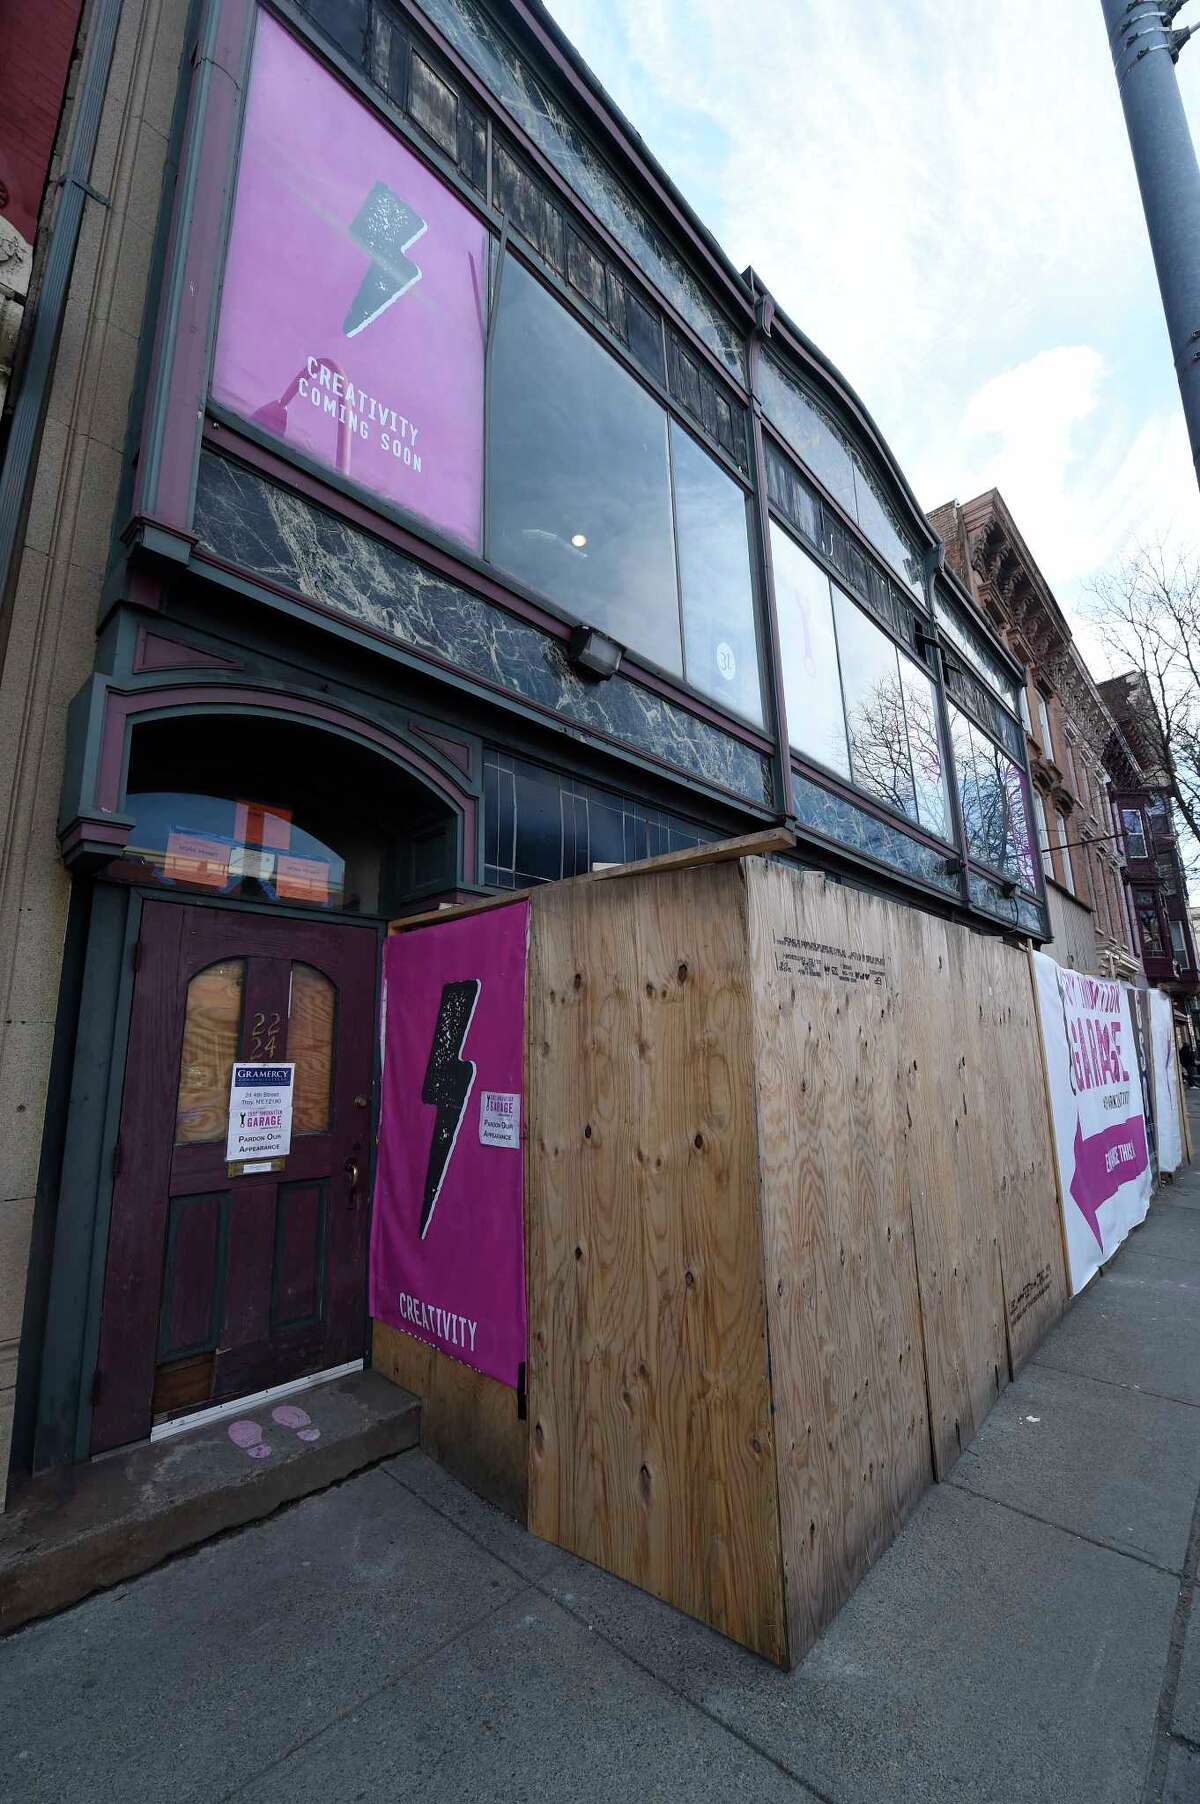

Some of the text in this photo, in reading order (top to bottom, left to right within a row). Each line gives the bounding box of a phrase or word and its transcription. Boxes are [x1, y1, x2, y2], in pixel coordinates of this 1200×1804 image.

[307, 356, 418, 447] CREATIVITY
[298, 377, 421, 473] COMING SOON
[252, 1012, 281, 1036] 22
[250, 1035, 276, 1060] 24
[237, 1069, 288, 1078] GRAMERCY
[247, 1115, 282, 1128] GARAGE
[239, 1133, 281, 1143] PARDON OUR
[240, 1144, 281, 1153] APPEARANCE
[399, 1291, 478, 1352] CREATIVITY
